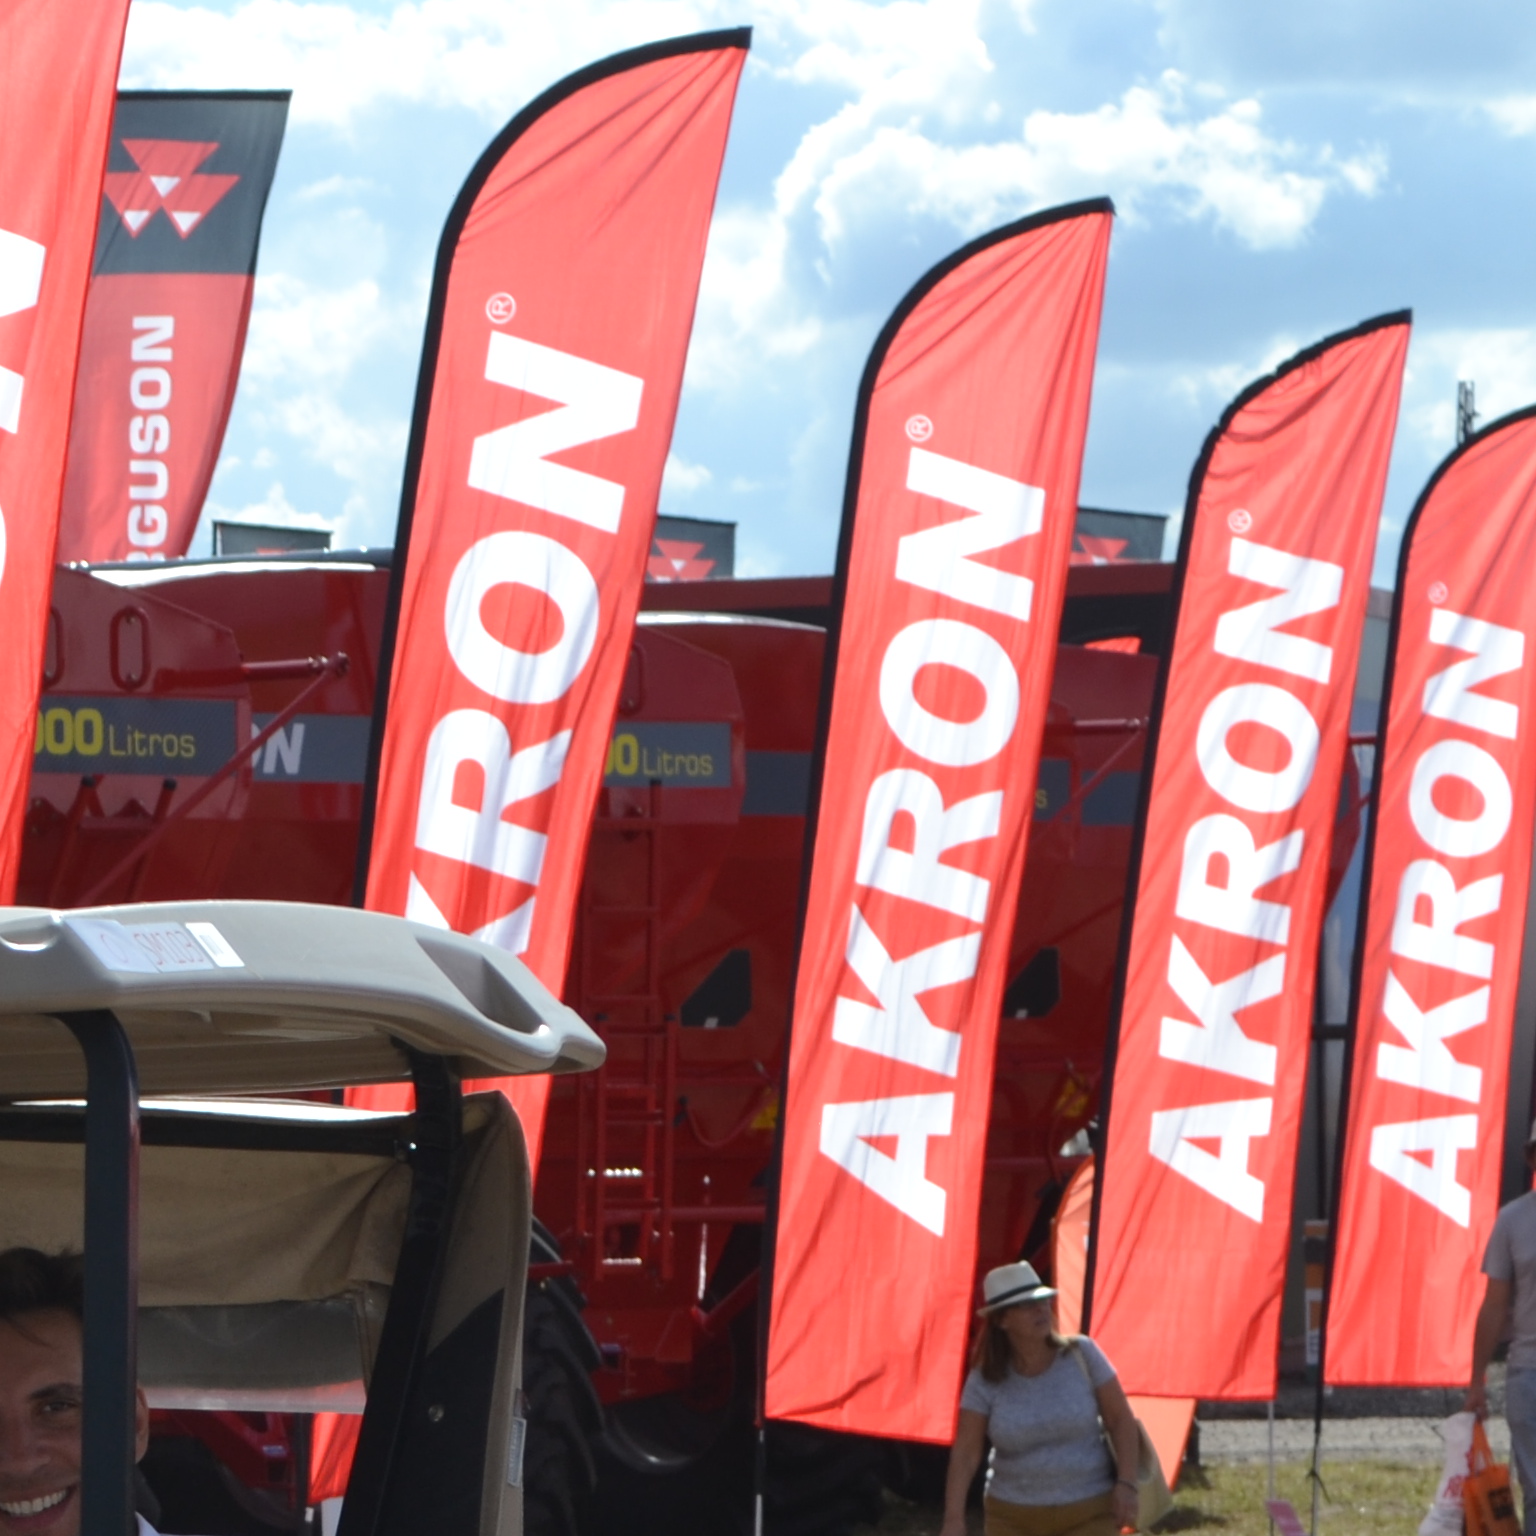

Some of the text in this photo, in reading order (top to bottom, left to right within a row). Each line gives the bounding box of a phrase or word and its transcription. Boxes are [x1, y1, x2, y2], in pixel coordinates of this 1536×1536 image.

[126, 315, 175, 561] GUSON
[109, 724, 196, 758] Litros
[642, 747, 714, 776] Litros
